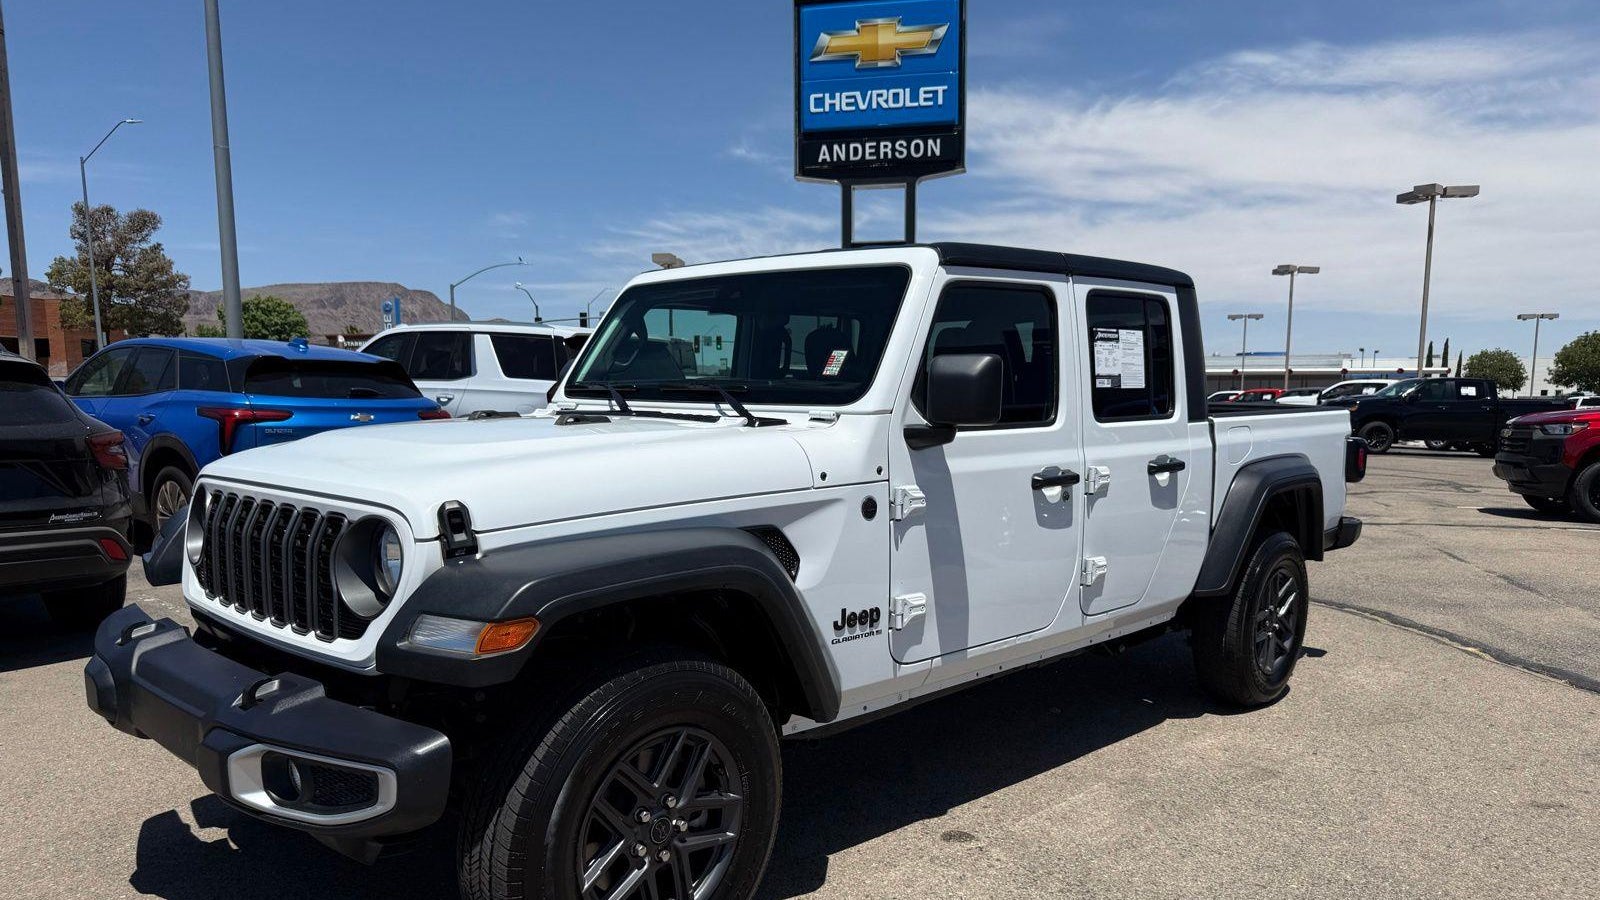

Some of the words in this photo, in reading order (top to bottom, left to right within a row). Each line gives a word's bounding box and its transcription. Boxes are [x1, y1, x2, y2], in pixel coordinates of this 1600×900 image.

[809, 85, 948, 113] CHEVROLET
[818, 138, 941, 163] ANDERSON
[833, 606, 881, 631] Jeep
[831, 630, 875, 645] GLADIATOR
